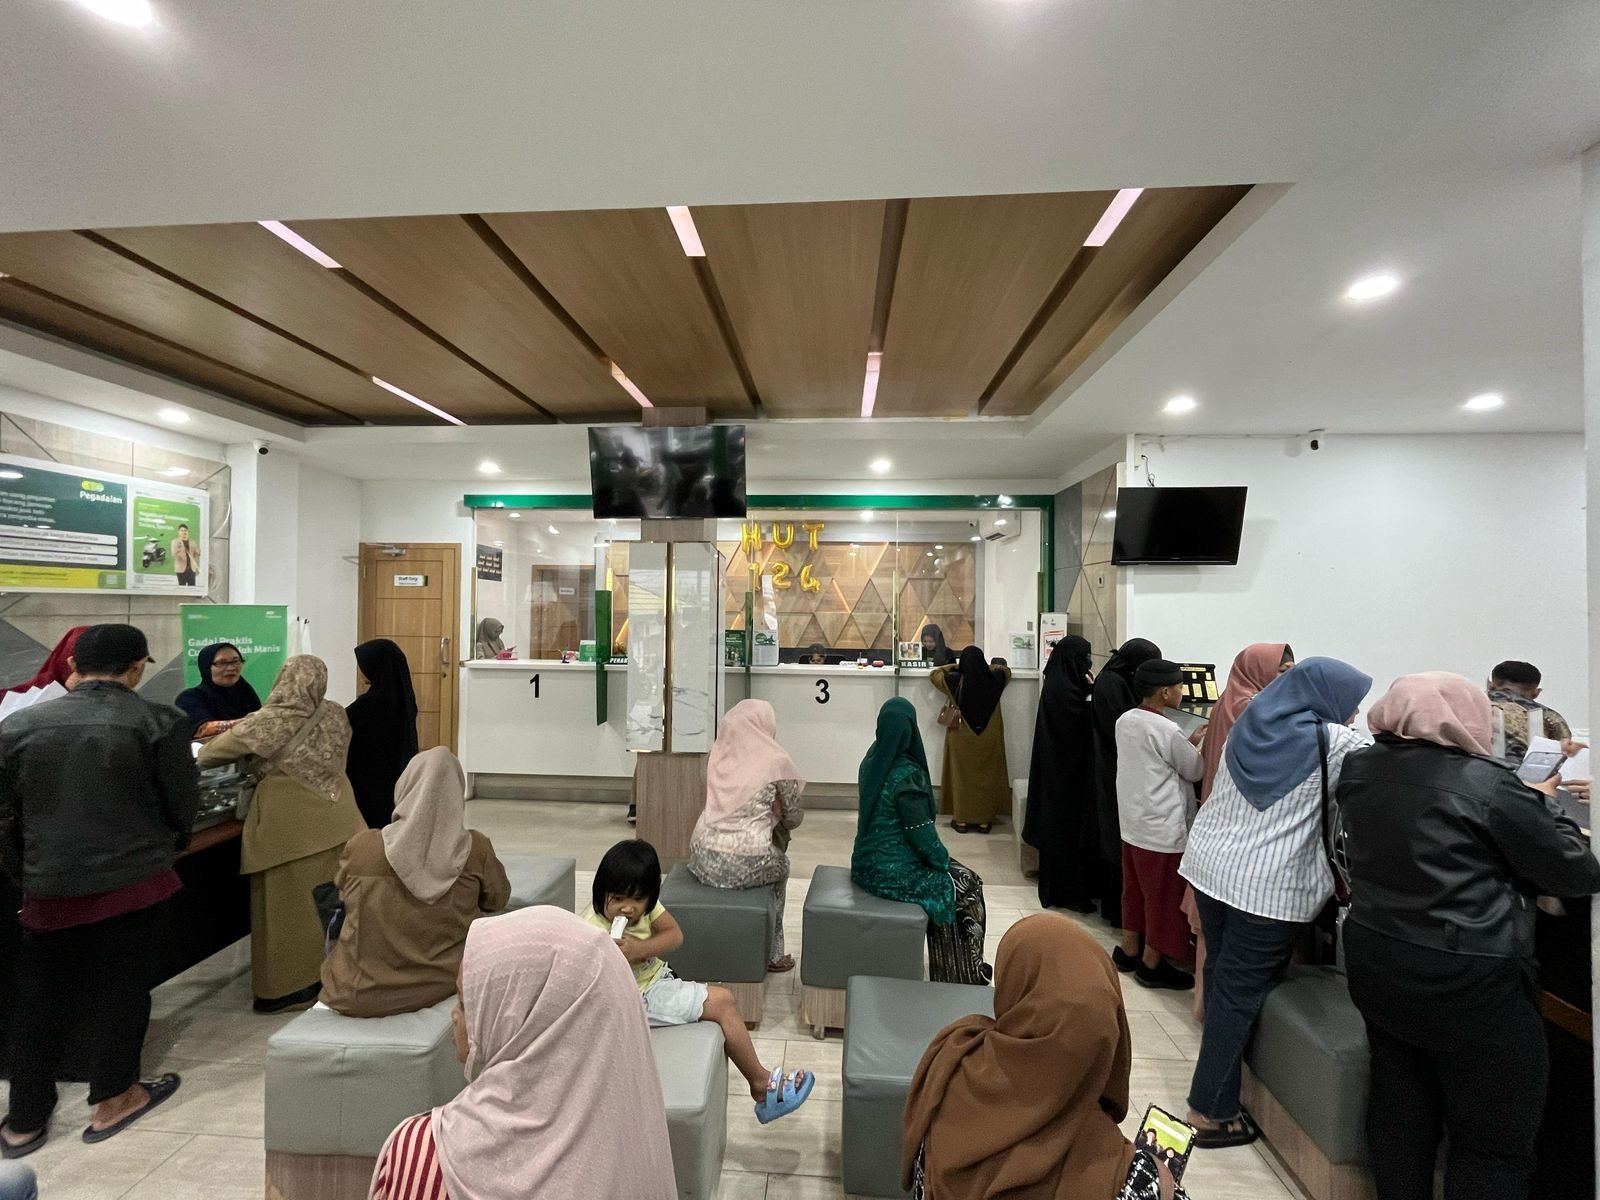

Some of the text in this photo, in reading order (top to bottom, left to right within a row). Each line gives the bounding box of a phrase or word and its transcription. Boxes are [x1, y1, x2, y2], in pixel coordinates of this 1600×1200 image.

[80, 490, 122, 504] Pegadaian
[742, 522, 824, 552] HUT
[750, 562, 821, 592] 124
[188, 636, 253, 647] Gadai Praktis
[254, 644, 280, 653] Manis
[530, 673, 540, 698] 1
[815, 679, 830, 704] 3
